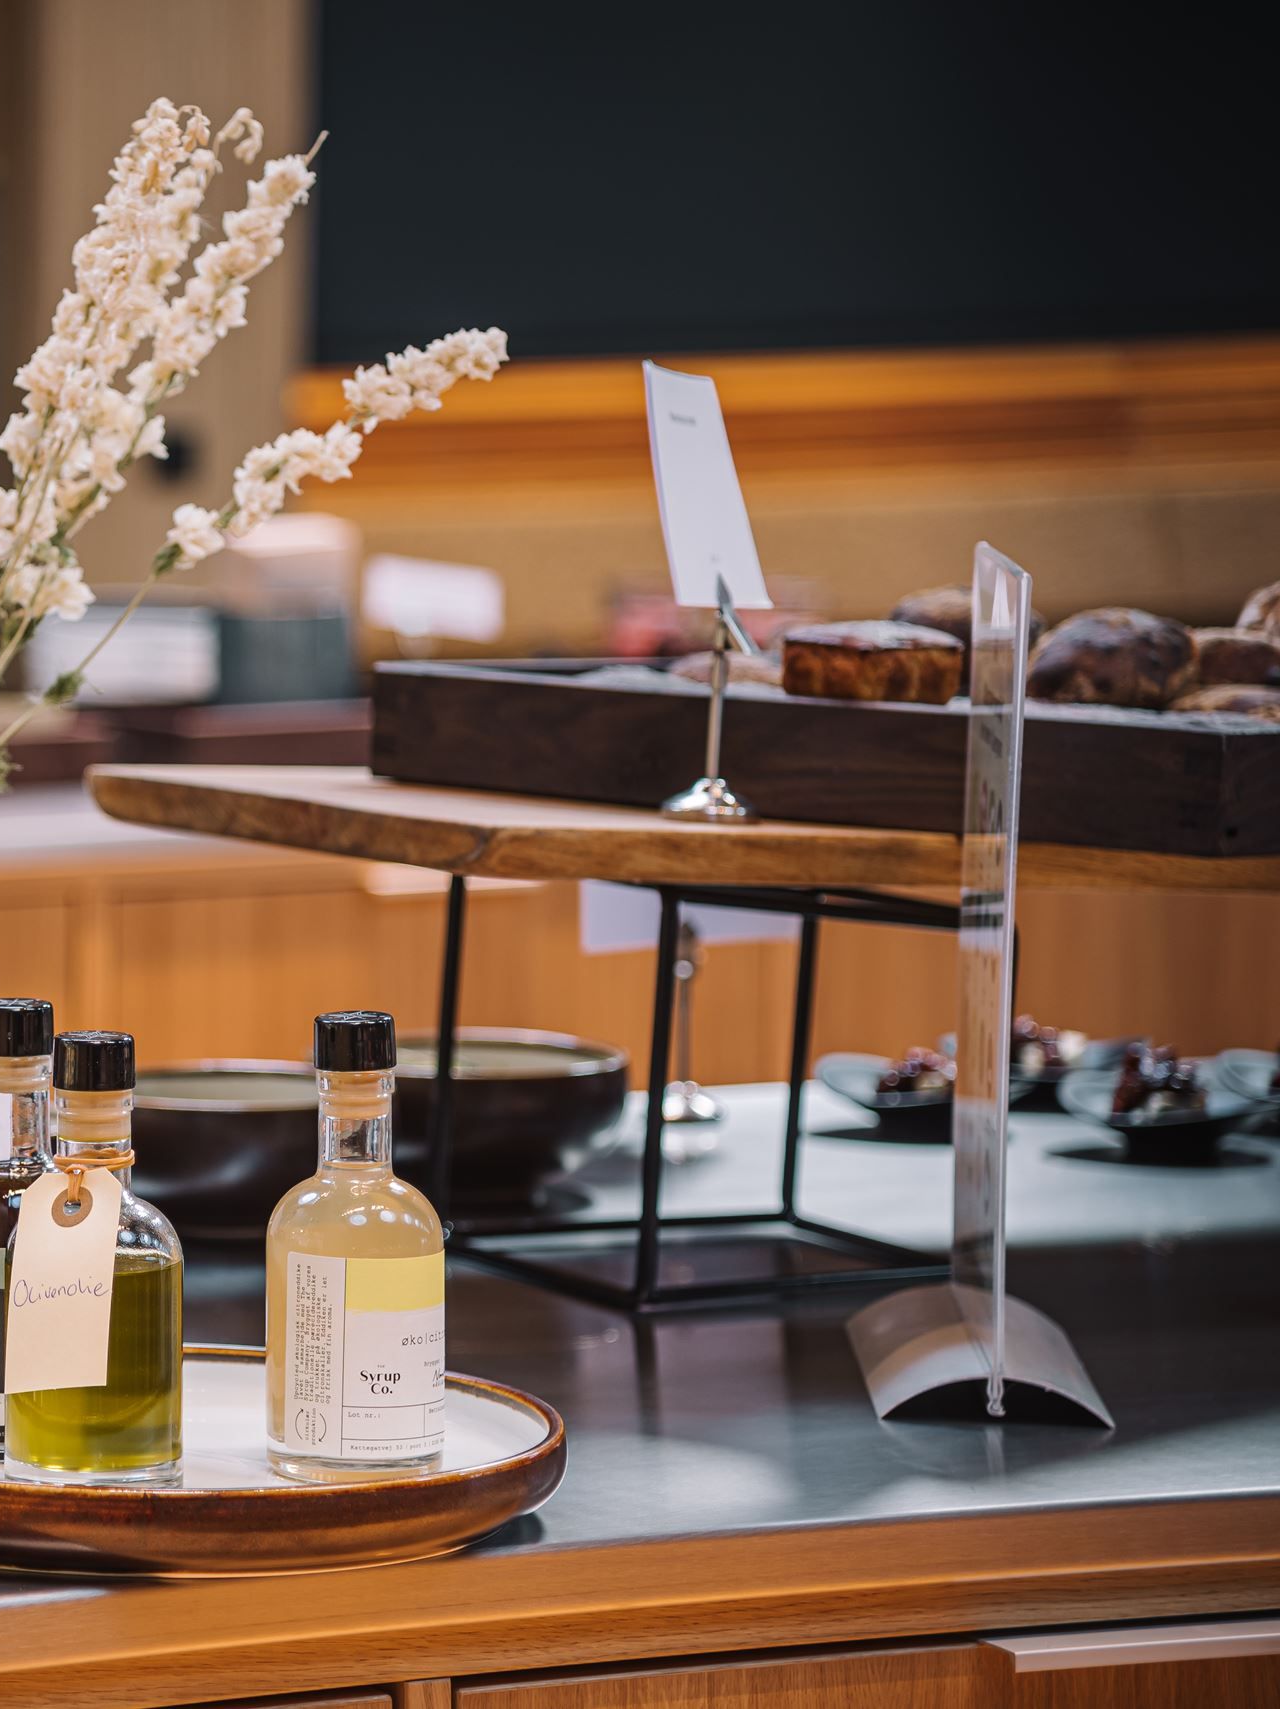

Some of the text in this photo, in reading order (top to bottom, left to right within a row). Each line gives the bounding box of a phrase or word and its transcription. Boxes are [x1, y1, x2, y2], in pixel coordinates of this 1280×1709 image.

[13, 1275, 110, 1308] Olivenolie
[306, 1291, 311, 1301] af
[322, 1293, 327, 1303] er
[315, 1345, 321, 1355] på
[360, 1370, 401, 1384] Syrup
[370, 1383, 393, 1395] Co.
[314, 1393, 320, 1403] og
[325, 1395, 331, 1404] og
[350, 1444, 392, 1452] Kattegatvej
